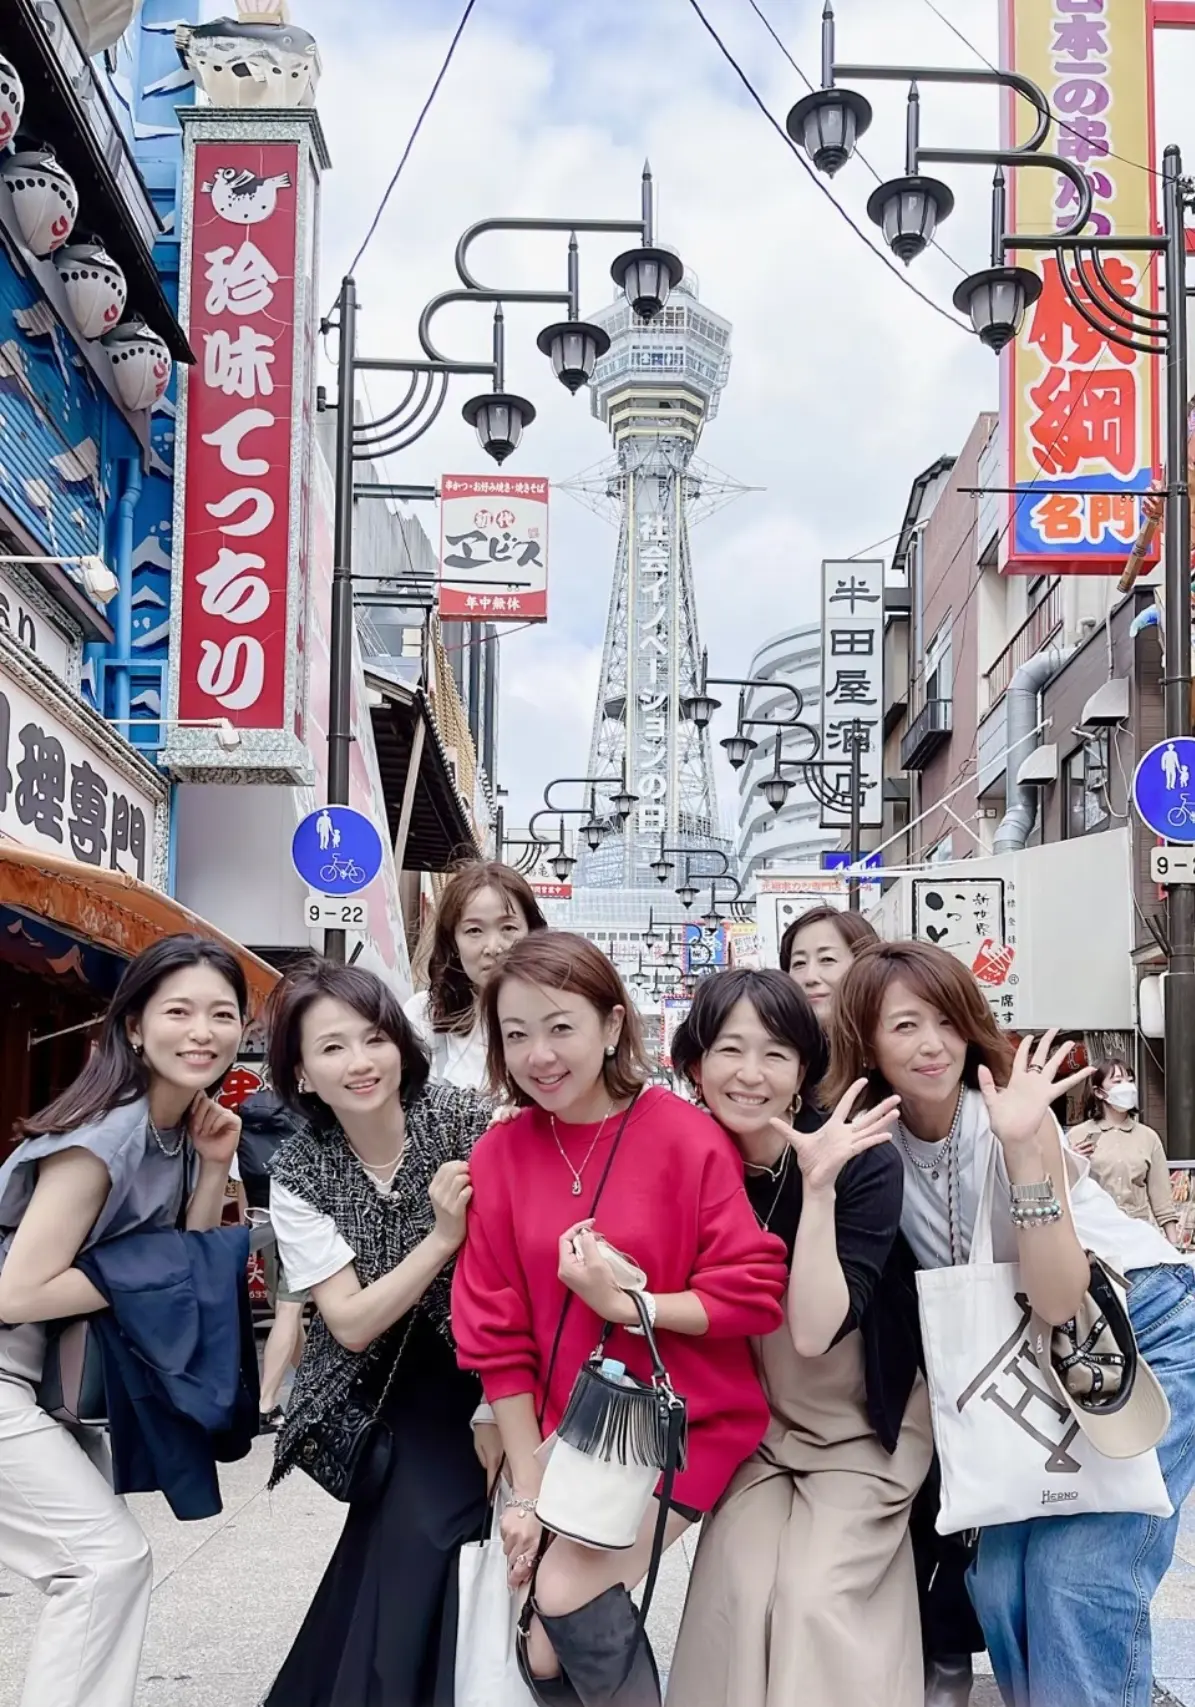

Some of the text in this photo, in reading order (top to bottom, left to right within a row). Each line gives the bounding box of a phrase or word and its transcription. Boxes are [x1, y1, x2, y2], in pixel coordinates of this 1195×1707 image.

[1052, 0, 1112, 238] 本一の串かつ
[1029, 257, 1137, 476] 横綱
[1036, 493, 1136, 540] 名門
[443, 530, 544, 569] エビス
[465, 596, 521, 611] 年中無休
[309, 905, 363, 922] 9-22
[1042, 1489, 1079, 1503] HERNO
